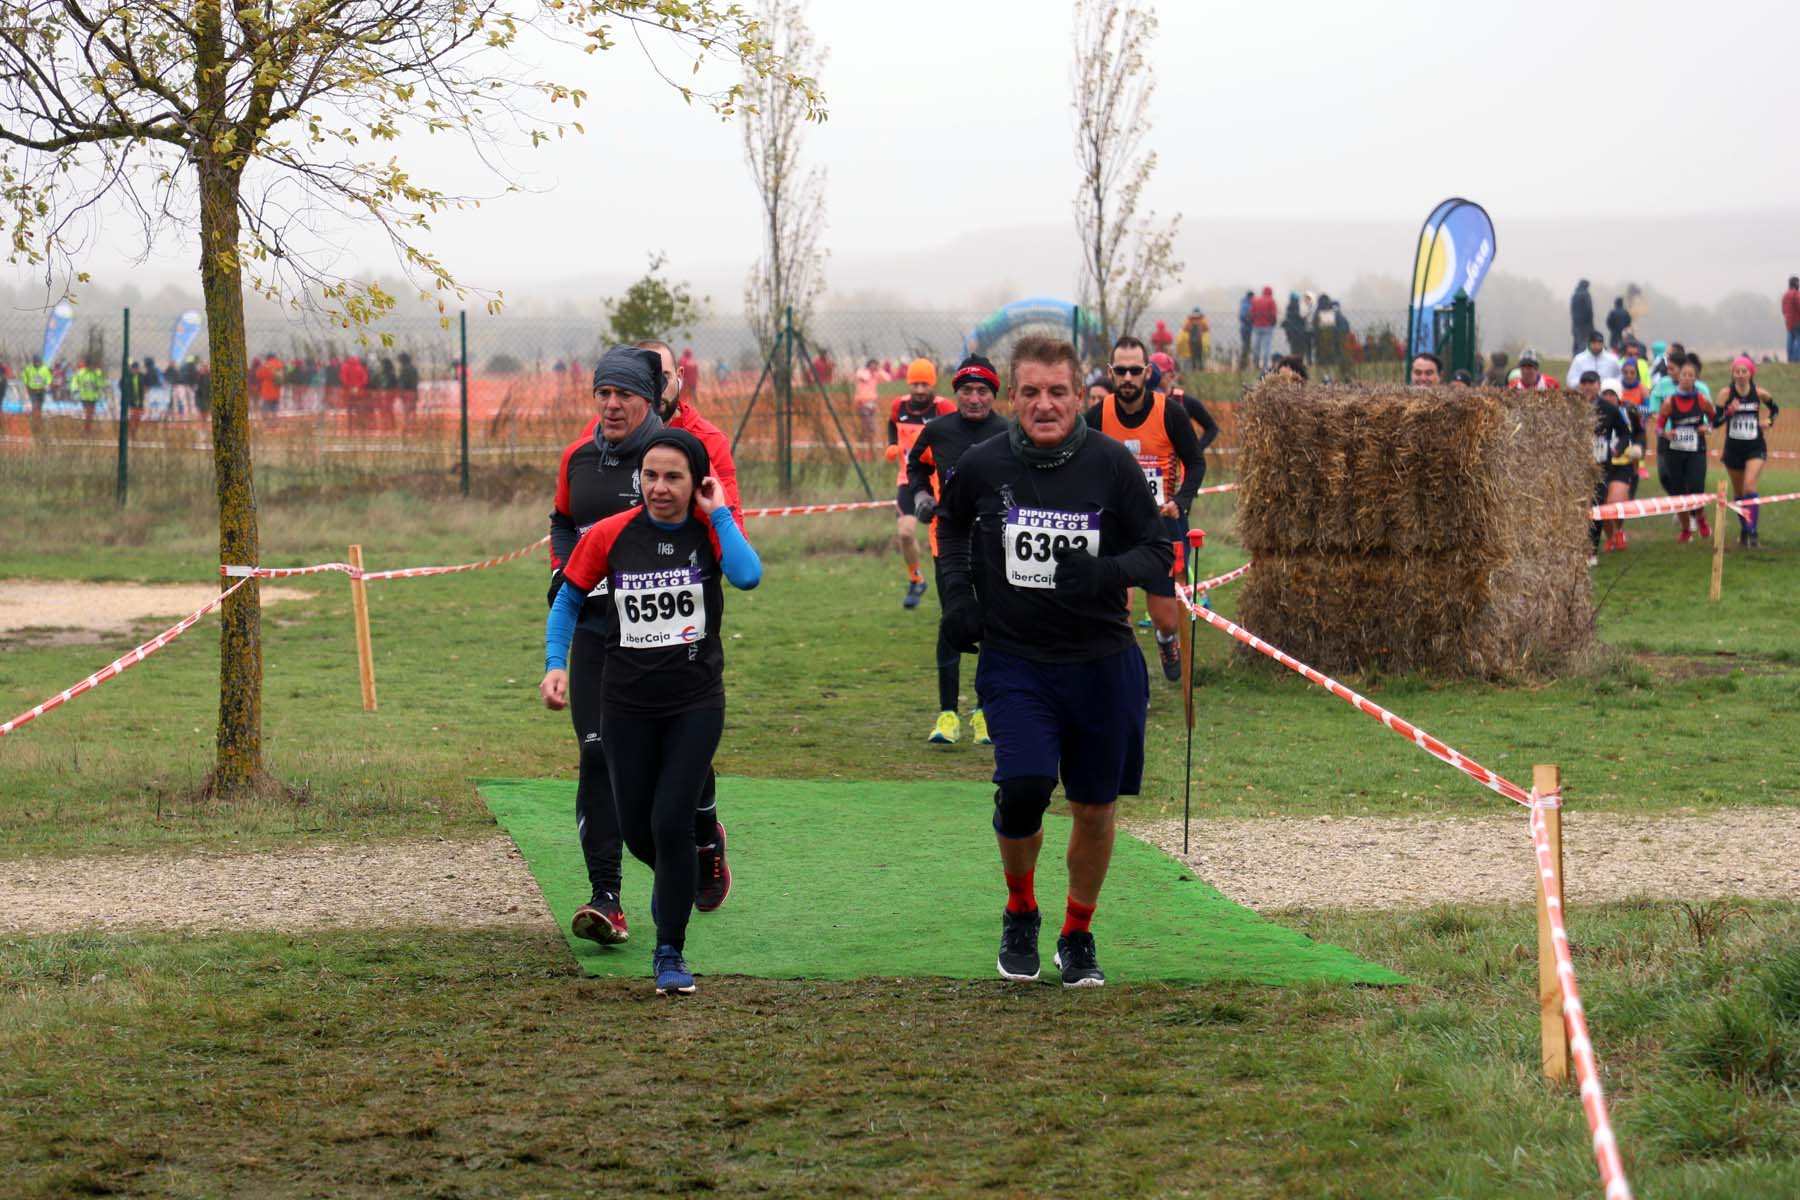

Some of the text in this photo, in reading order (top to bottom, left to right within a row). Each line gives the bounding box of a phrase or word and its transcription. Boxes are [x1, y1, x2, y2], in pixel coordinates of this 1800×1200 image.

[1018, 509, 1089, 522] DIPUTACIÓN
[1017, 517, 1089, 530] BURGOS
[622, 569, 690, 581] DIPUTACIÓN
[622, 576, 691, 589] BURGOS
[624, 590, 695, 624] 6596
[626, 632, 671, 643] iberCaja
